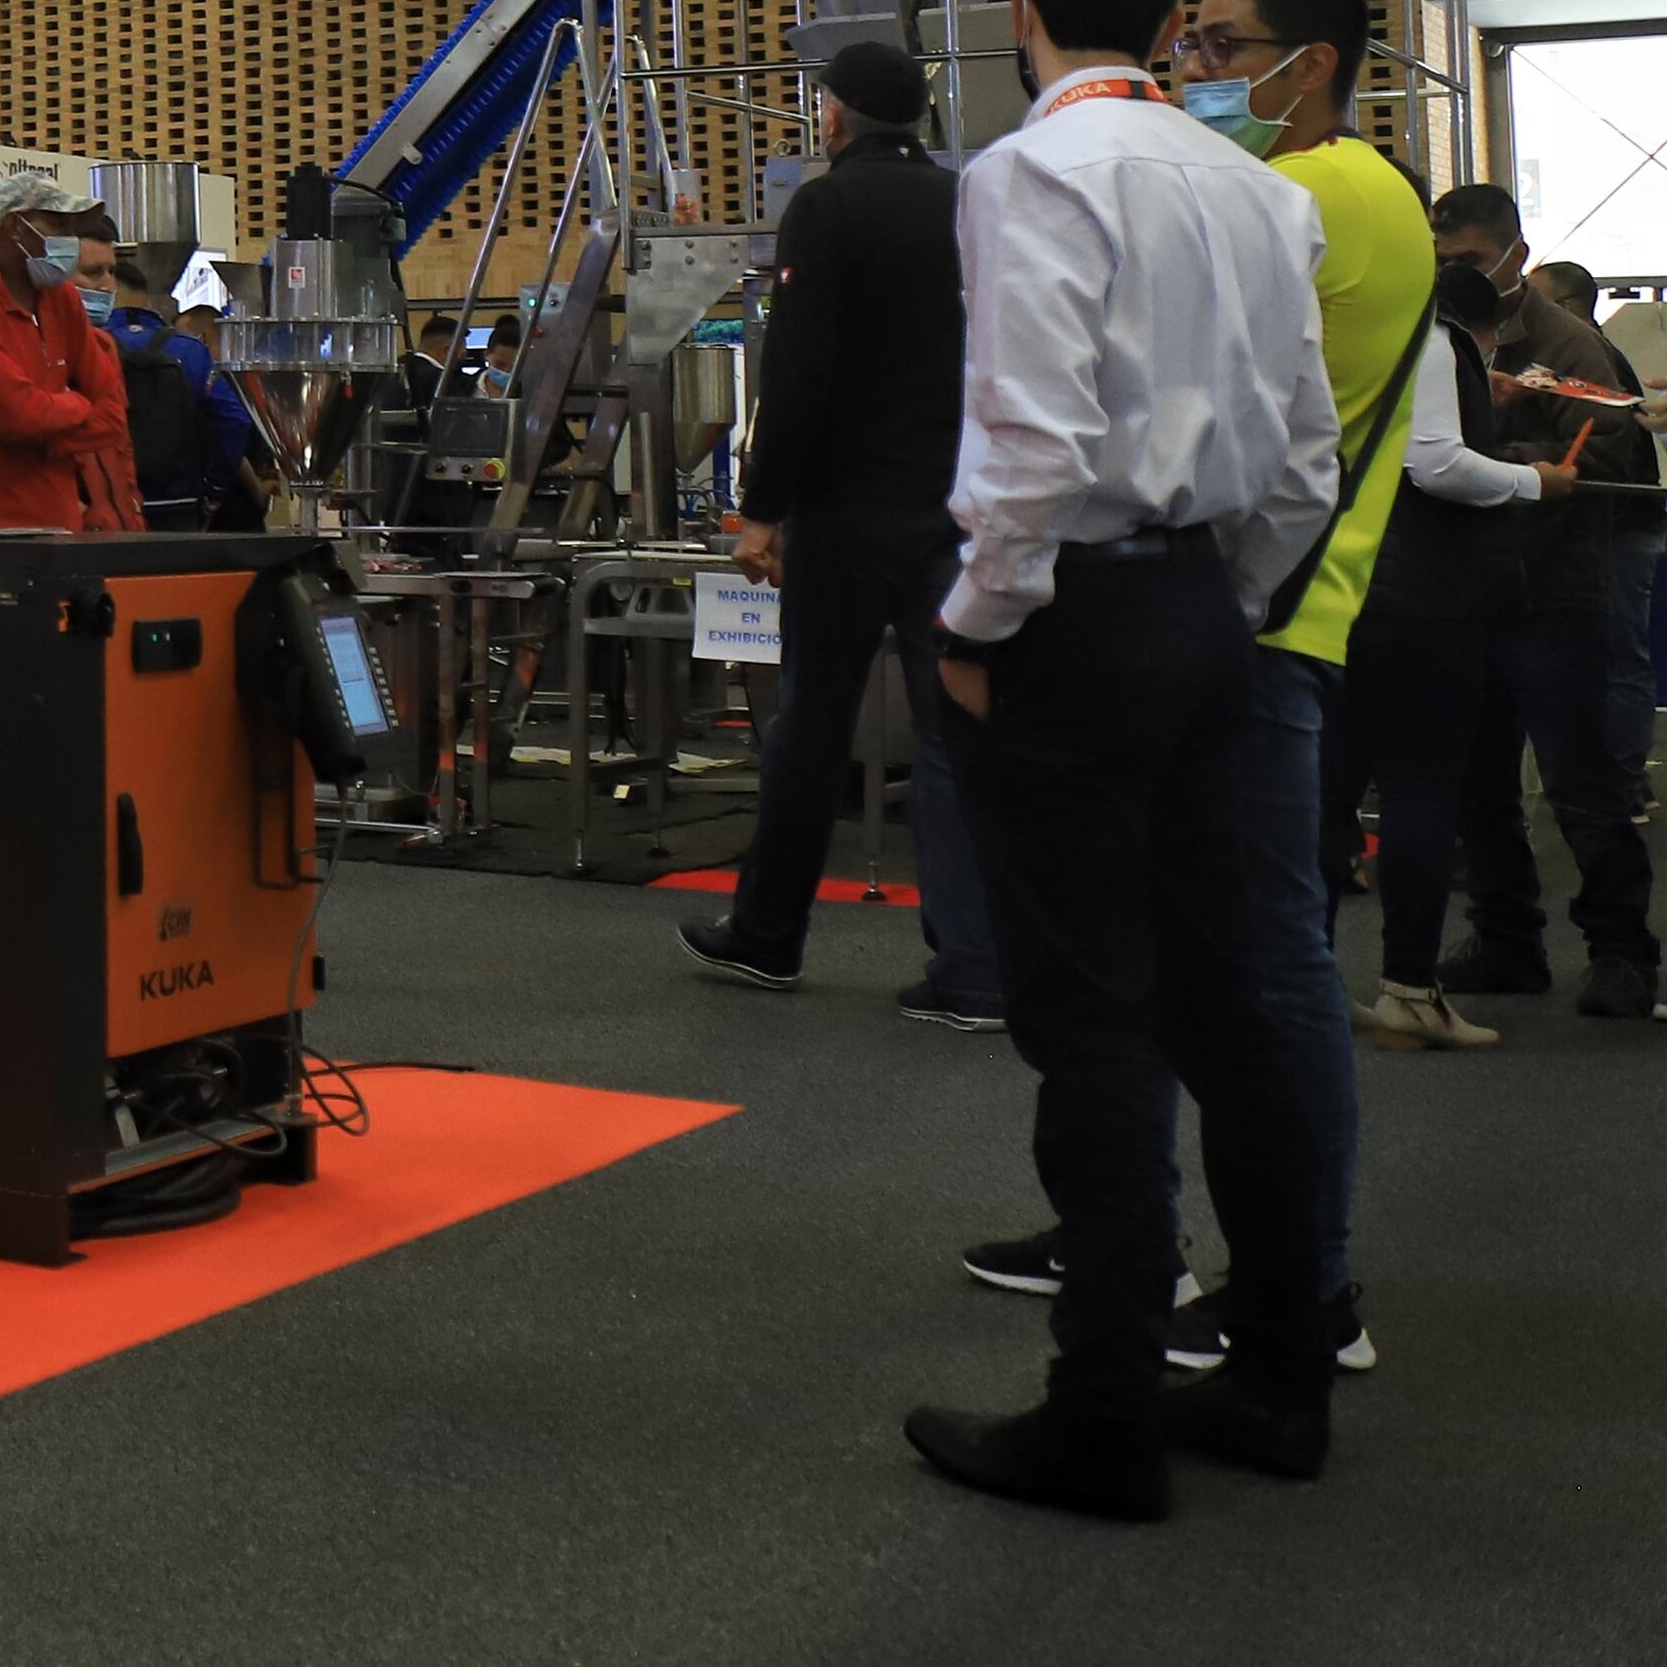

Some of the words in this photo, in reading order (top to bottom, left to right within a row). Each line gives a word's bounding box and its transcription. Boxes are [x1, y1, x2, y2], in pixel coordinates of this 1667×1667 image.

[741, 612, 761, 624] EN
[708, 630, 782, 645] EXHIBICIO
[140, 960, 214, 1001] KUKA
